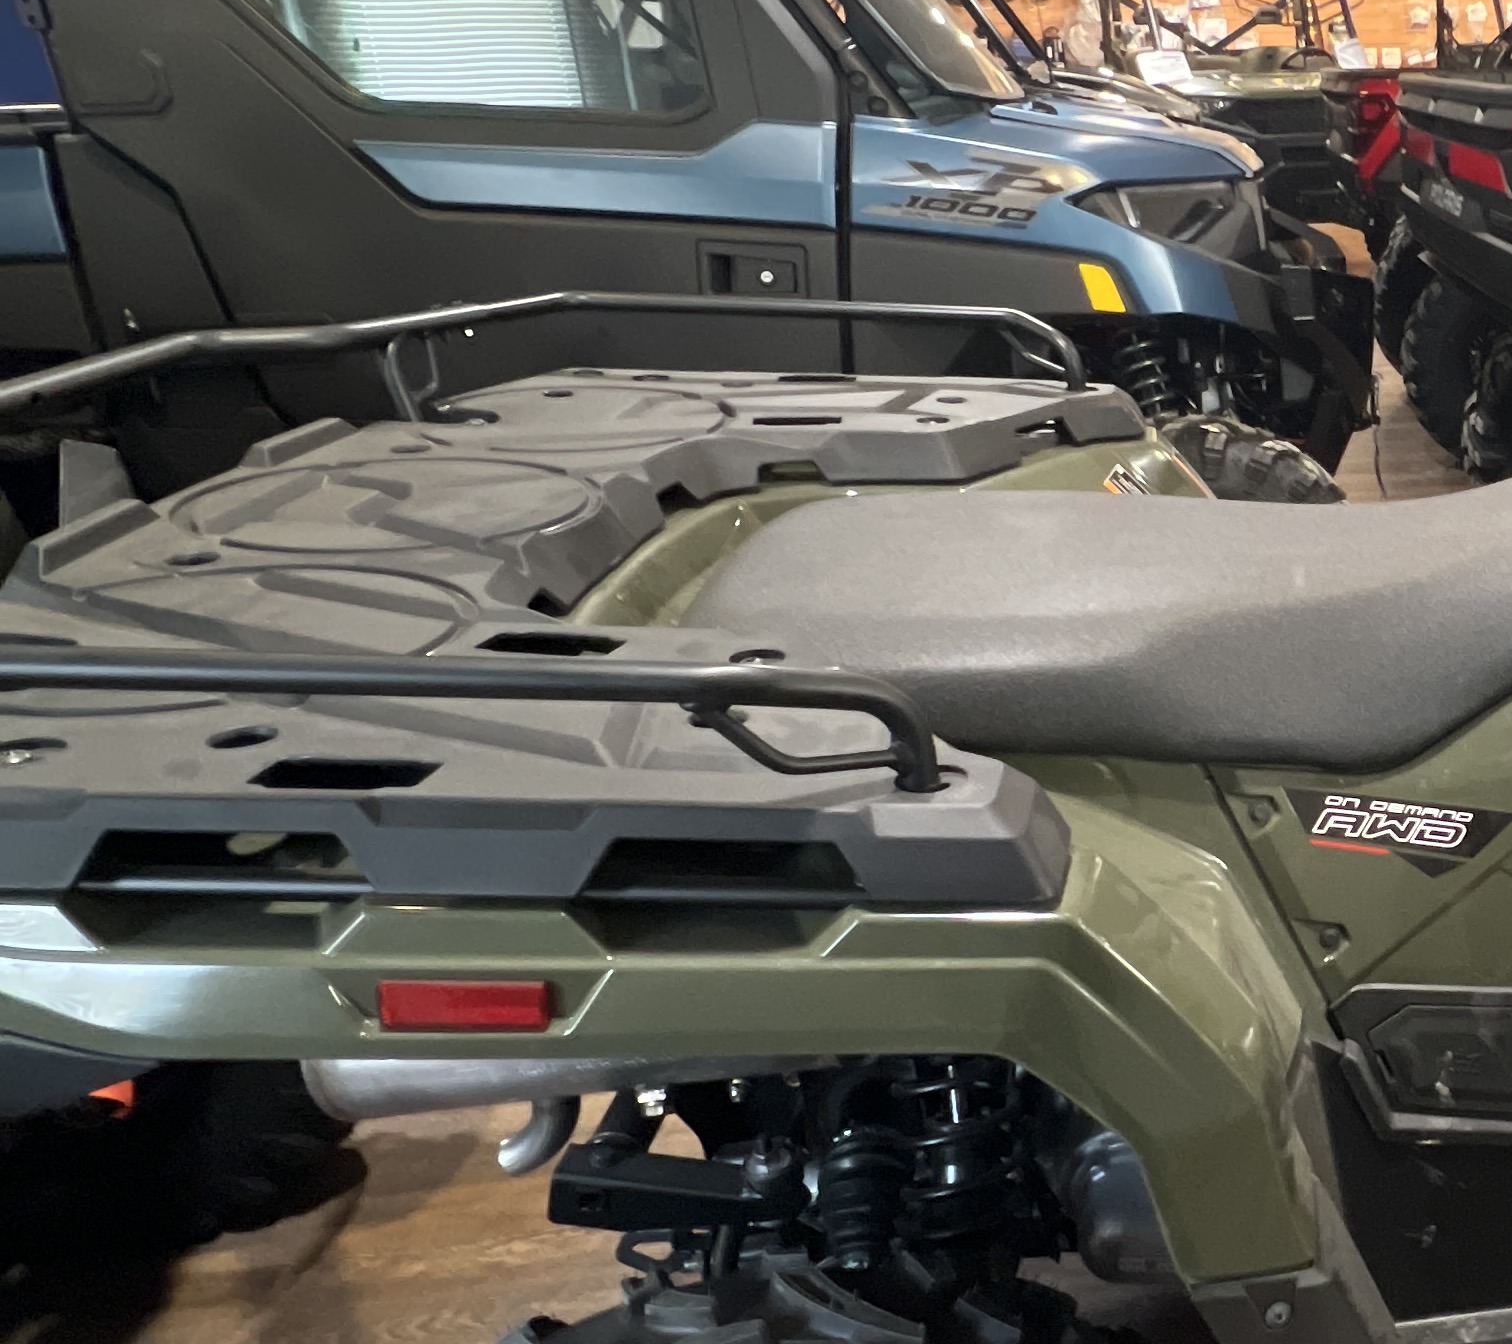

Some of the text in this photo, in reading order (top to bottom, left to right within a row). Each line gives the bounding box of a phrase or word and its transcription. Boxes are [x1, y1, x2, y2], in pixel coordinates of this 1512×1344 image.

[880, 159, 1065, 196] XP
[904, 194, 1037, 222] 1000
[1311, 807, 1468, 848] AWD
